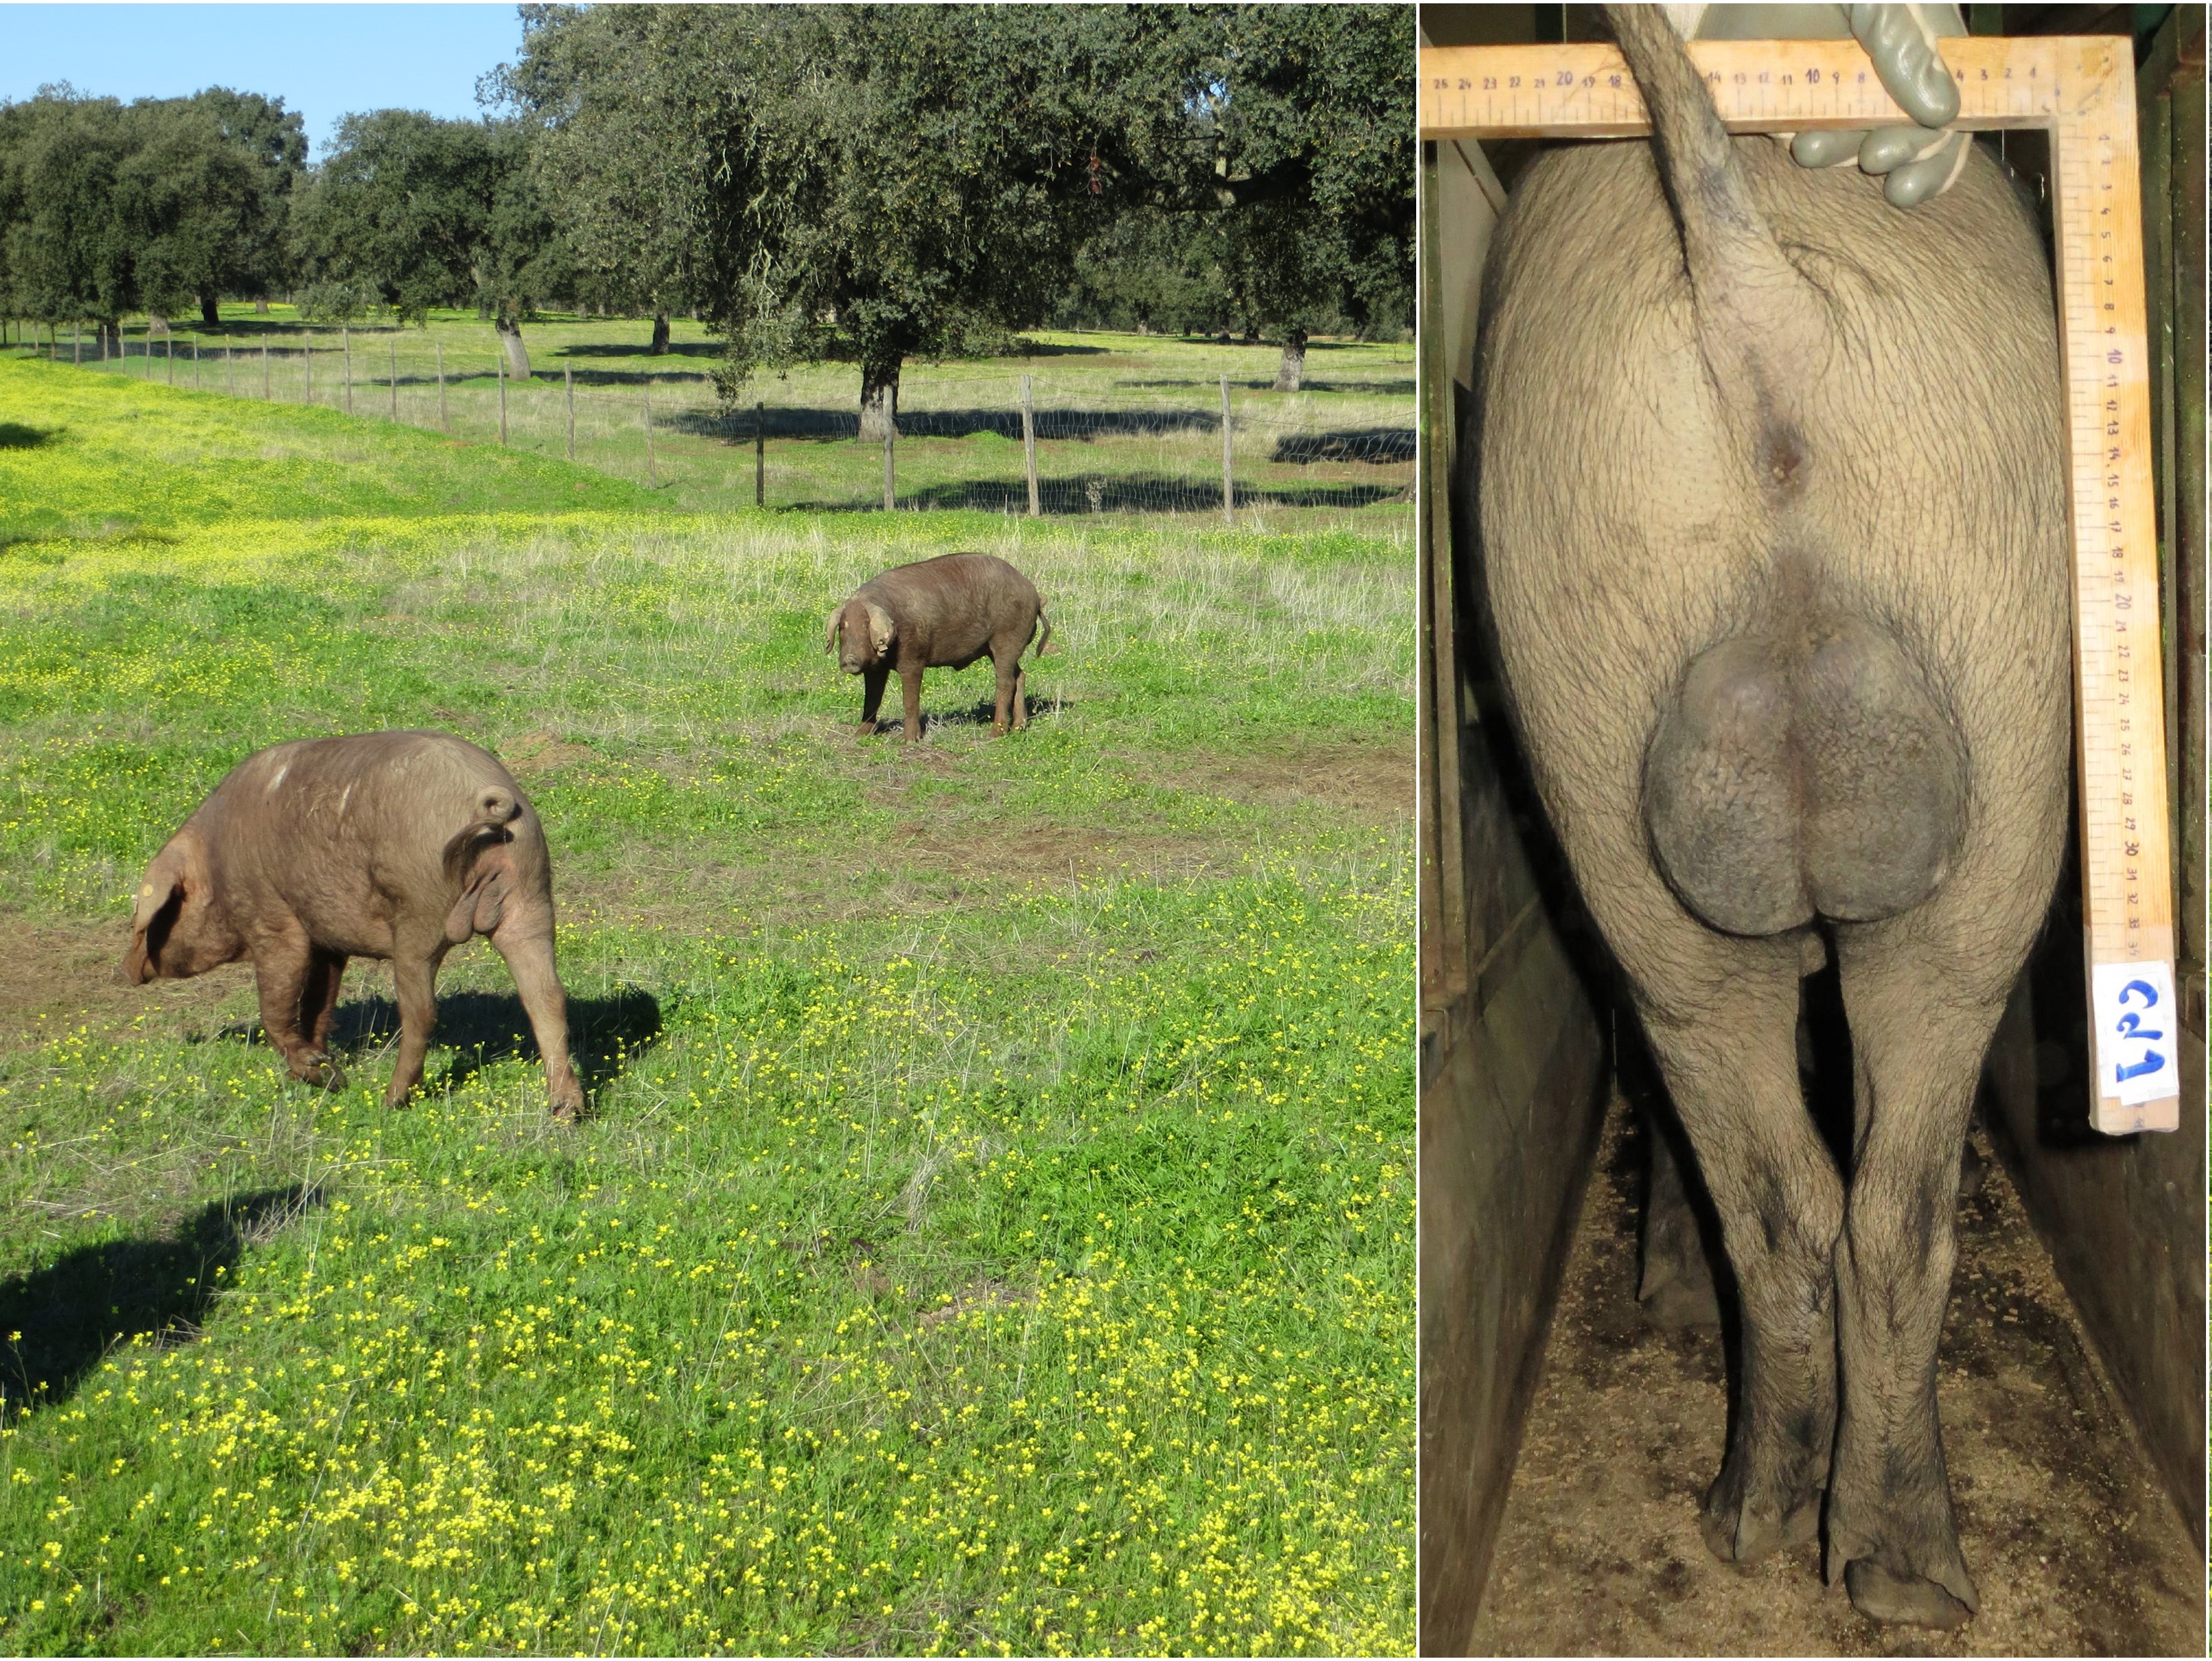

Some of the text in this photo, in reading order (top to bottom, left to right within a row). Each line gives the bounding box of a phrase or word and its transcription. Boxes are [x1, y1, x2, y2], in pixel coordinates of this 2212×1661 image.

[1459, 77, 1472, 90] 24
[1484, 77, 1496, 89] 23
[1510, 76, 1521, 87] 22
[1534, 78, 1544, 89] 21
[1556, 71, 1573, 86] 20
[1582, 77, 1596, 89] 19
[1608, 75, 1622, 87] 18
[1708, 72, 1721, 83] 14
[1734, 73, 1746, 85] 13
[1758, 72, 1770, 83] 12
[1782, 75, 1792, 85] 11
[1806, 69, 1820, 83] 10
[1832, 73, 1839, 84] 9
[1957, 70, 1964, 81] 4
[1981, 69, 1988, 80] 3
[2005, 69, 2011, 78] 2
[2107, 349, 2123, 364] 10
[2107, 375, 2117, 388] 11
[2107, 400, 2118, 411] 12
[2107, 422, 2119, 436] 13
[2108, 448, 2120, 460] 14
[2108, 474, 2119, 488] 15
[2108, 496, 2119, 508] 16
[2110, 521, 2121, 533] 17
[2112, 547, 2123, 558] 18
[2114, 571, 2123, 583] 19
[2115, 594, 2131, 610] 20
[2115, 620, 2126, 632] 21
[2118, 645, 2129, 658] 22
[2118, 669, 2127, 682] 23
[2119, 694, 2129, 705] 24
[2120, 719, 2130, 732] 25
[2121, 743, 2131, 756] 26
[2123, 767, 2132, 780] 27
[2123, 792, 2133, 804] 28
[2125, 817, 2136, 831] 29
[2125, 841, 2140, 857] 30
[2127, 867, 2137, 881] 31
[2128, 893, 2138, 905] 32
[2129, 917, 2140, 930] 33
[2128, 941, 2139, 956] 34
